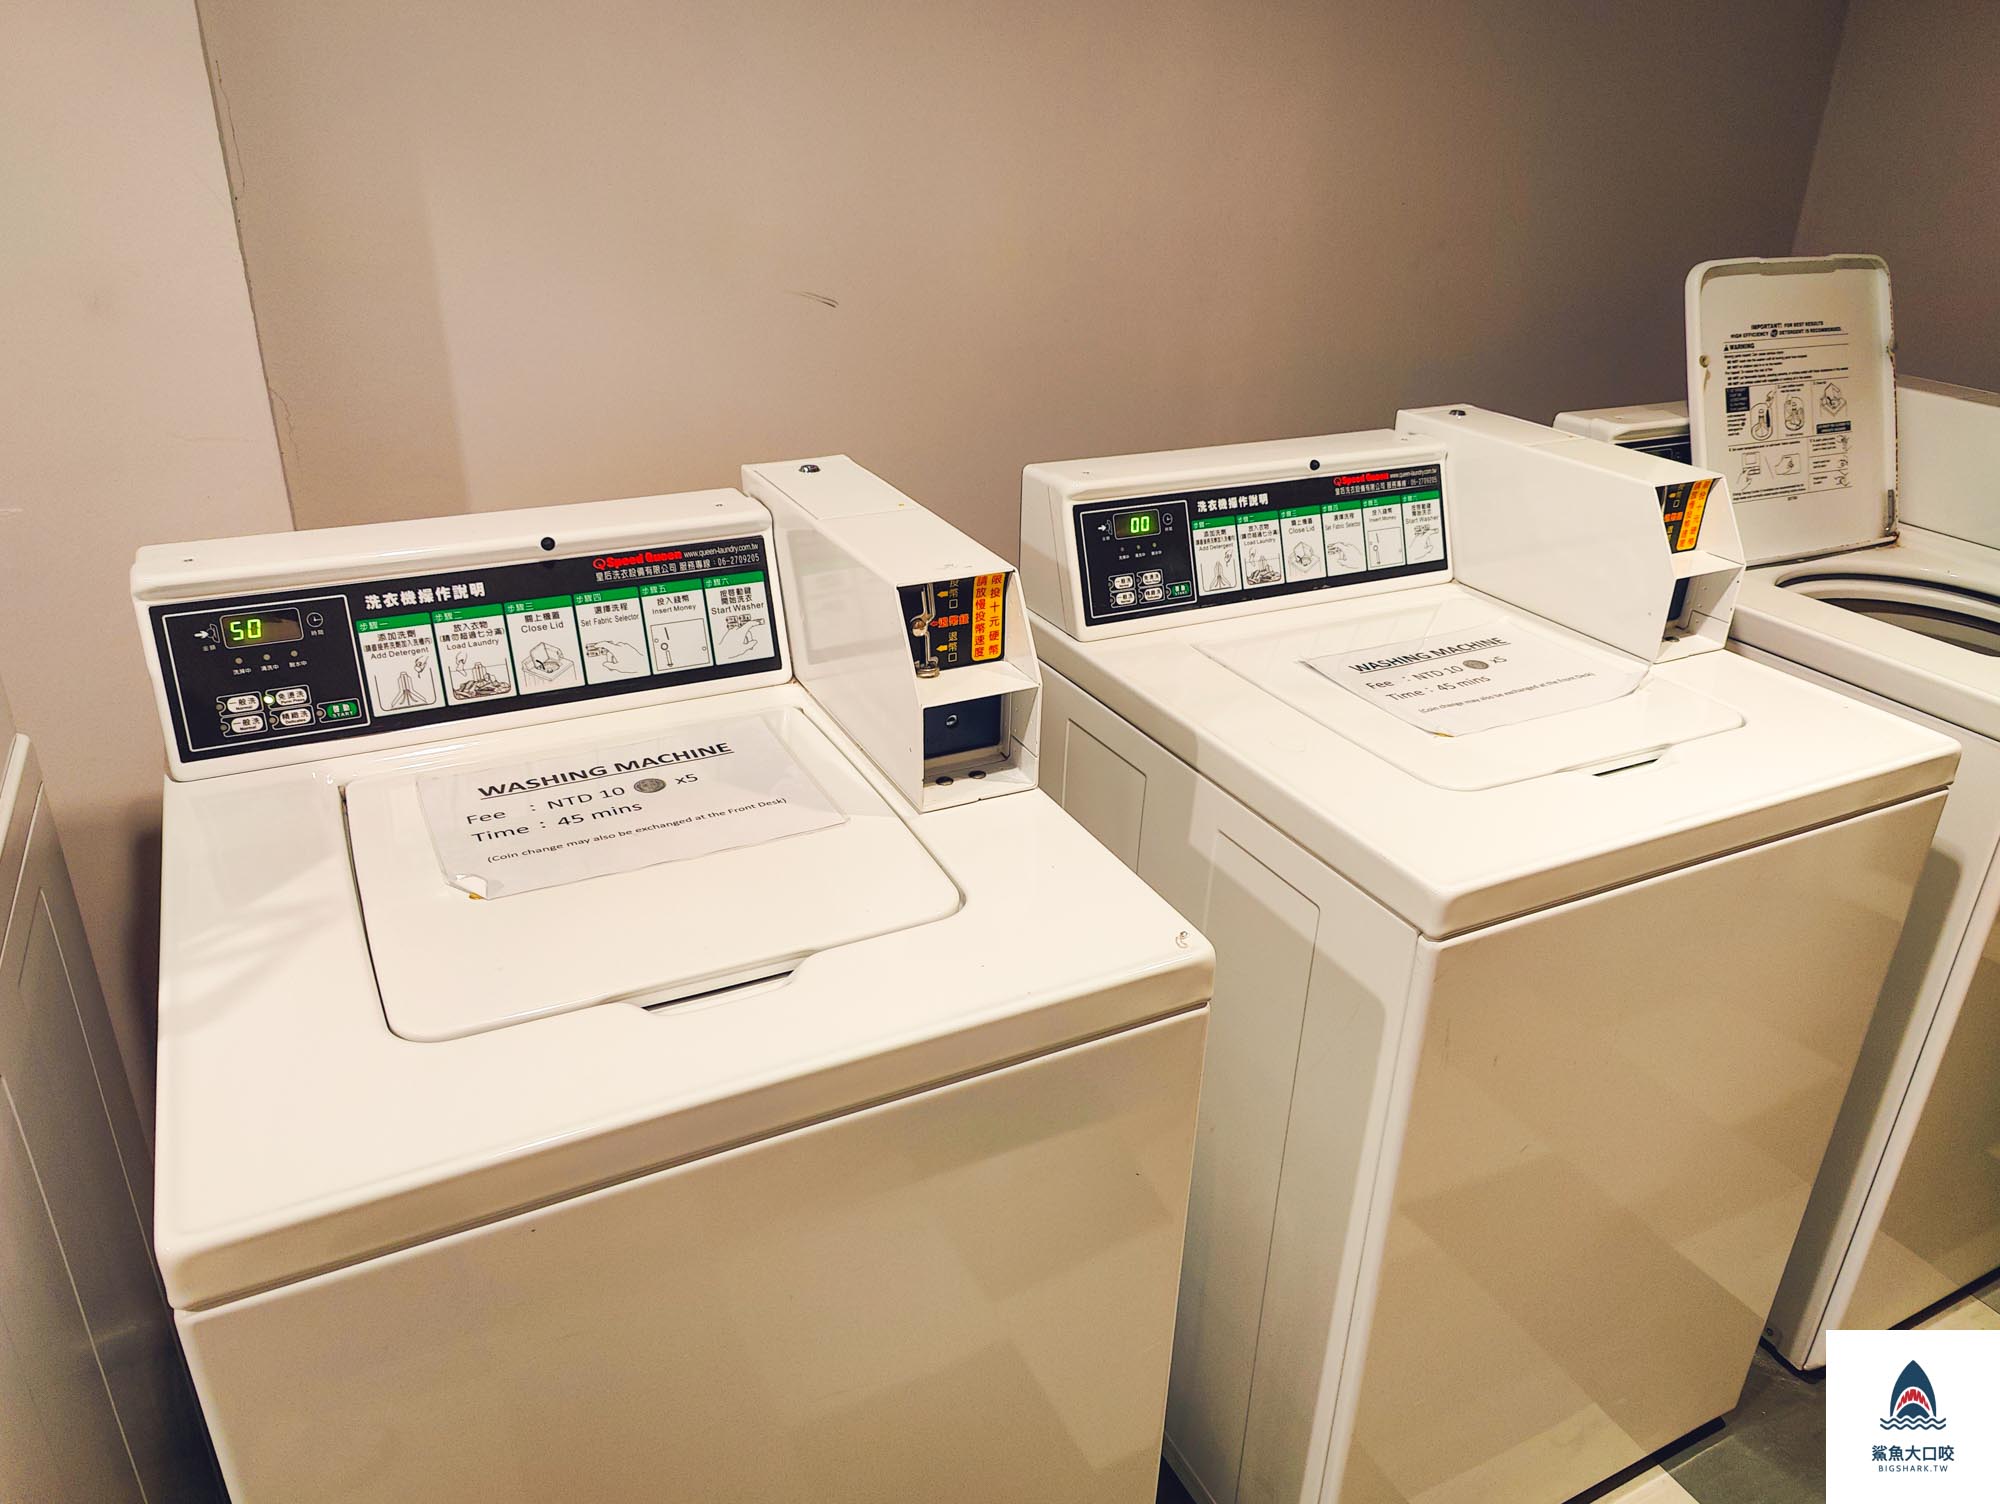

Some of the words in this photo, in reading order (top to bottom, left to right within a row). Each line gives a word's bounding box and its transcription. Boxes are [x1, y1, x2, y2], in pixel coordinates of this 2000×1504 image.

[1730, 342, 1755, 350] WARNING
[1130, 516, 1150, 533] 00
[606, 552, 644, 568] Speed
[645, 550, 682, 563] Queen
[684, 543, 759, 558] www.queen-laundry.com.tw
[364, 582, 486, 610] 洗衣機操作說明
[652, 607, 672, 615] Insert
[674, 604, 696, 614] Money
[711, 606, 732, 615] Start
[734, 602, 764, 613] Washer
[230, 619, 261, 640] 50
[520, 622, 547, 633] Close
[549, 621, 564, 630] Lid
[580, 619, 592, 627] Set
[594, 616, 612, 625] Fabric
[614, 614, 639, 623] Selector
[370, 651, 388, 660] Add
[389, 646, 429, 658] Detergent
[447, 642, 467, 651] Load
[468, 638, 499, 648] Laundry
[1348, 652, 1431, 672] WASHING
[1429, 637, 1507, 657] MACHINE
[1366, 680, 1394, 689] Fee
[1412, 670, 1444, 680] NTD
[1444, 665, 1464, 674] 10
[1489, 656, 1508, 664] x5
[1386, 690, 1425, 701] Time
[1437, 682, 1456, 691] 45
[1457, 676, 1491, 687] mins
[478, 766, 608, 797] WASHING
[614, 742, 732, 773] MACHINE
[466, 810, 507, 824] Fee
[547, 794, 593, 810] NTD
[600, 787, 625, 799] 10
[675, 774, 698, 785] x5
[471, 825, 529, 843] Time
[557, 814, 585, 827] 45
[591, 802, 643, 820] mins
[487, 852, 519, 864] (Coin
[521, 844, 564, 857] change
[566, 837, 590, 848] may
[593, 832, 616, 842] also
[618, 829, 633, 837] be
[635, 816, 693, 833] exchanged
[708, 808, 726, 818] the
[727, 802, 756, 814] Front
[757, 798, 787, 808] Desk)
